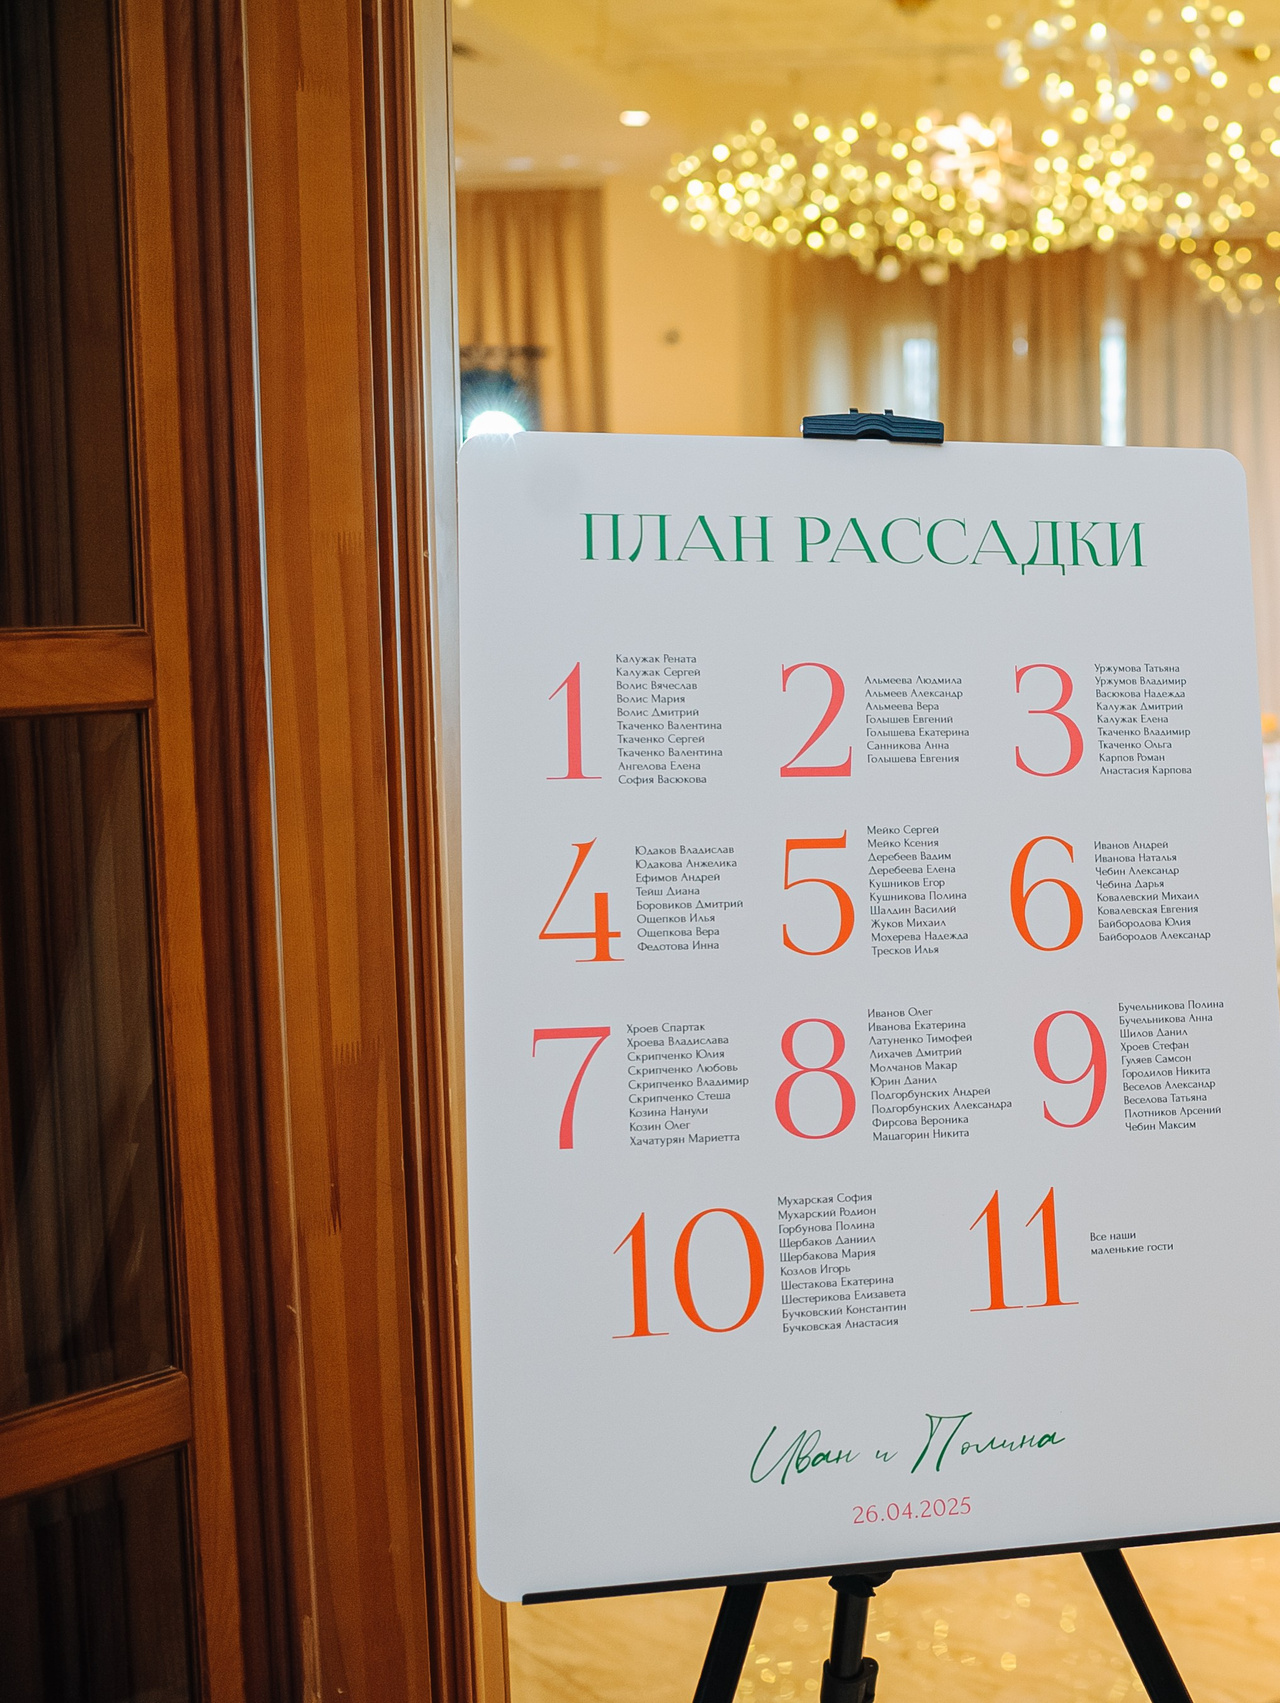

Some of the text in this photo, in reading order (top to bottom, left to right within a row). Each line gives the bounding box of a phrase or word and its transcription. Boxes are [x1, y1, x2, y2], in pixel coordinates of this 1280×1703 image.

[580, 513, 1147, 576] ПЛАН РАССАДКИ
[616, 653, 697, 666] Калужак Рената
[1093, 663, 1180, 675] Уржумова Татьяна
[616, 680, 698, 690] Волис Вячеслав
[864, 675, 962, 685] Альмеева Людмила
[616, 693, 686, 706] Волис Мария
[865, 689, 964, 700] Альмеев Александр
[1095, 688, 1186, 698] Васюкова Надежда
[546, 662, 602, 780] 1
[617, 720, 722, 731] Ткаченко Валентина
[780, 662, 852, 777] 2
[865, 714, 954, 724] Голышев Евгений
[1015, 664, 1083, 777] 3
[1097, 714, 1169, 726] Калужак Елена
[617, 733, 705, 746] Ткаченко Сергей
[866, 727, 970, 739] Голышева Екатерина
[866, 740, 950, 751] Санникова Анна
[1098, 739, 1172, 750] Ткаченко Ольга
[1099, 752, 1165, 765] Карпов Роман
[618, 760, 701, 771] Ангелова Елена
[1099, 765, 1192, 777] Анастасия Карпова
[618, 774, 707, 787] София Васюкова
[867, 838, 939, 848] Мейко Ксения
[1094, 840, 1169, 851] Иванов Андрей
[635, 845, 735, 856] Юдаков Владислав
[867, 851, 952, 864] Деребеев Вадим
[1095, 866, 1180, 877] Чебин Александр
[635, 872, 721, 885] Ефимов Андрей
[869, 877, 946, 891] Кушников Егор
[1095, 879, 1165, 891] Чебина Дарья
[636, 886, 700, 897] Тейш Диана
[783, 829, 855, 956] 5
[1010, 836, 1083, 951] 6
[1096, 891, 1200, 903] Ковалевский Михаил
[539, 837, 624, 962] 4
[636, 900, 744, 913] Боровиков Дмитрий
[870, 904, 957, 915] Шалдин Василий
[1097, 904, 1199, 916] Ковалевская Евгения
[636, 912, 716, 924] Ощепков Илья
[871, 918, 947, 931] Жуков Михаил
[871, 931, 969, 944] Мохерева Надежда
[1098, 931, 1211, 943] Байбородов Александр
[637, 940, 720, 952] Федотова Инна
[871, 944, 939, 958] Тресков Илья
[867, 1006, 933, 1018] Иванов Олег
[1118, 999, 1224, 1014] Бучельникова Полина
[626, 1022, 706, 1036] Хроев Спартак
[1119, 1028, 1188, 1039] Шилов Данил
[627, 1036, 729, 1050] Хроева Владислава
[868, 1033, 973, 1048] Латуненко Тимофей
[1120, 1040, 1190, 1054] Хроев Стефан
[627, 1048, 725, 1064] Скрипченко Юлия
[869, 1048, 962, 1059] Лихачев Дмитрий
[870, 1061, 958, 1073] Молчанов Макар
[1121, 1053, 1192, 1068] Гуляев Самсон
[1033, 1010, 1107, 1128] 9
[1122, 1066, 1211, 1081] Городилов Никита
[628, 1077, 750, 1092] Скрипченко Владимир
[775, 1018, 856, 1139] 8
[870, 1076, 938, 1089] Юрин Данил
[532, 1026, 611, 1149] 7
[1122, 1080, 1216, 1092] Веселов Александр
[871, 1087, 991, 1101] Подгорбунских Андрей
[629, 1106, 709, 1118] Козина Нанули
[1124, 1106, 1222, 1118] Плотников Арсений
[871, 1115, 969, 1130] Фирсова Вероника
[630, 1133, 740, 1148] Хачатурян Мариетта
[777, 1192, 873, 1208] Мухарская София
[778, 1206, 877, 1222] Мухарский Родион
[778, 1220, 875, 1236] Горбунова Полина
[779, 1235, 876, 1250] Щербаков Даниил
[1090, 1232, 1137, 1242] Все наши
[969, 1187, 1079, 1312] 11
[1090, 1243, 1174, 1255] маленькие гости
[612, 1208, 764, 1339] 10
[780, 1264, 851, 1277] Козлов Игорь
[781, 1276, 894, 1291] Шестакова Екатерина
[782, 1304, 907, 1321] Бучковский Константин
[750, 1412, 1065, 1485] Иван и Полина
[853, 1497, 971, 1524] 26.04.2025
